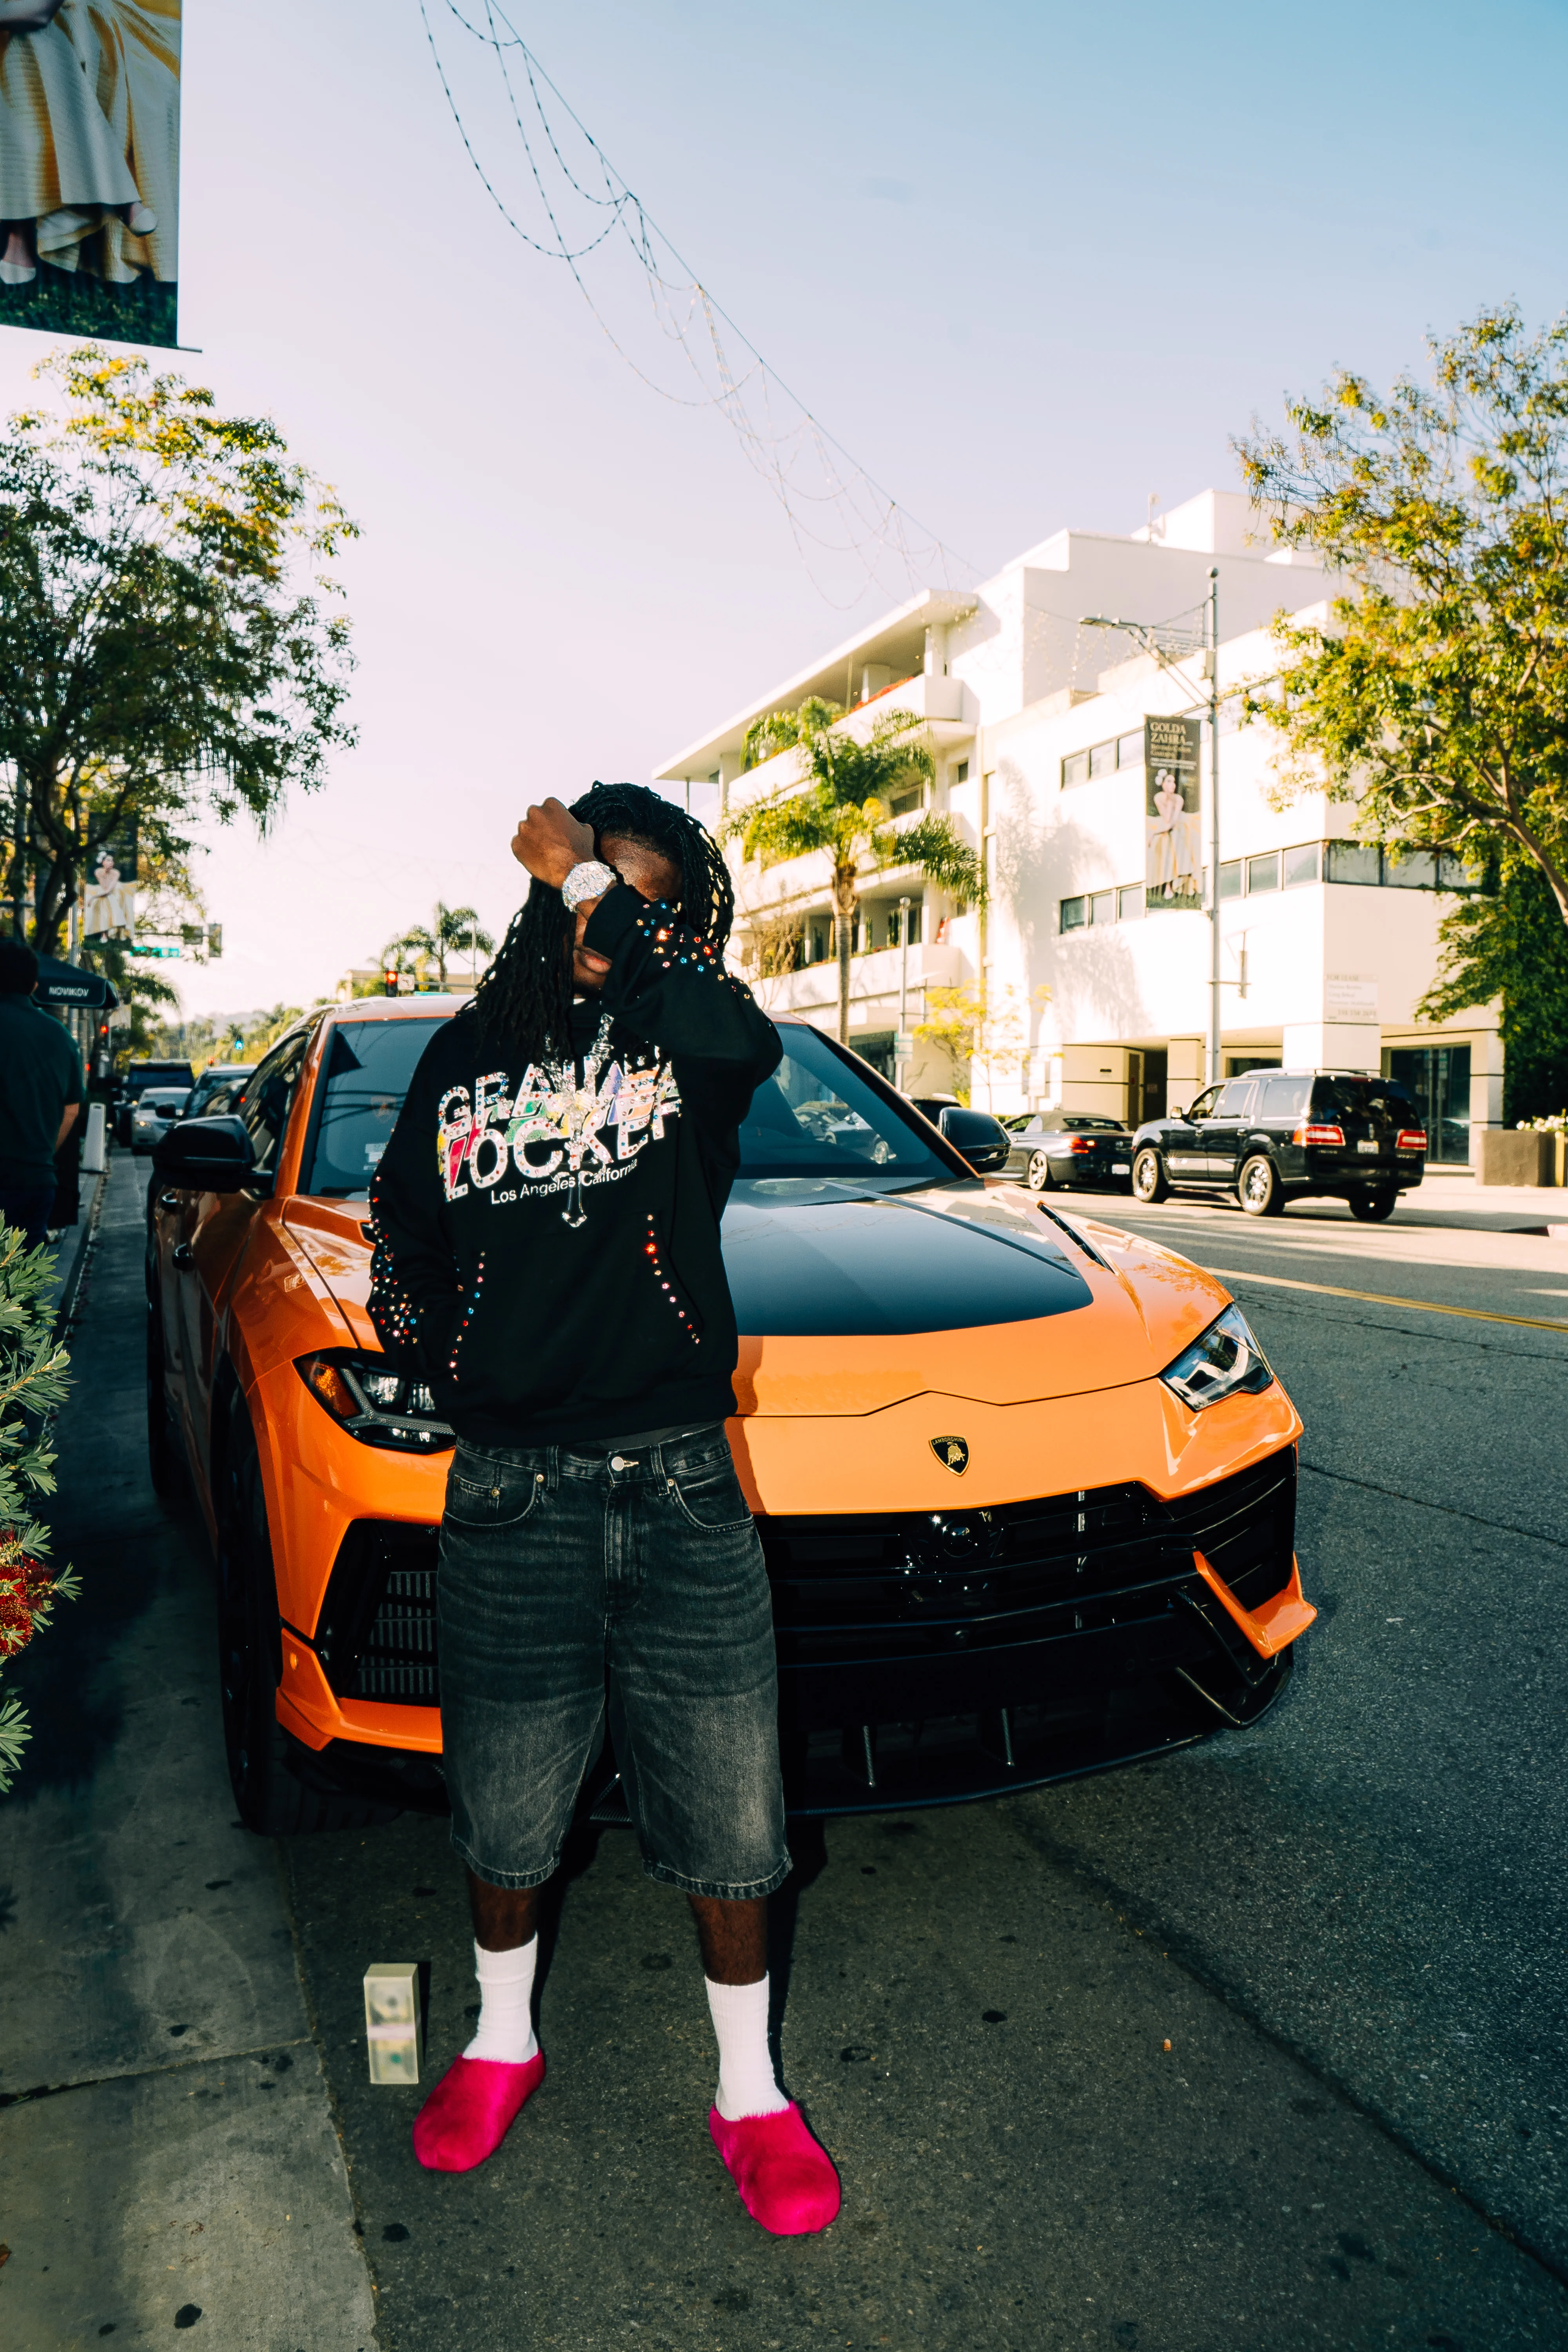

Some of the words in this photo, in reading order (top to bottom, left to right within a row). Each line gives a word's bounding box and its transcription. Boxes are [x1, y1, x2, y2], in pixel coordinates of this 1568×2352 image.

[1150, 722, 1186, 735] GOLDA
[1150, 732, 1186, 746] ZAHRA
[49, 986, 89, 997] NOVIKOV
[491, 1190, 517, 1205] Los
[520, 1177, 575, 1198] Angeles
[581, 1158, 637, 1186] California
